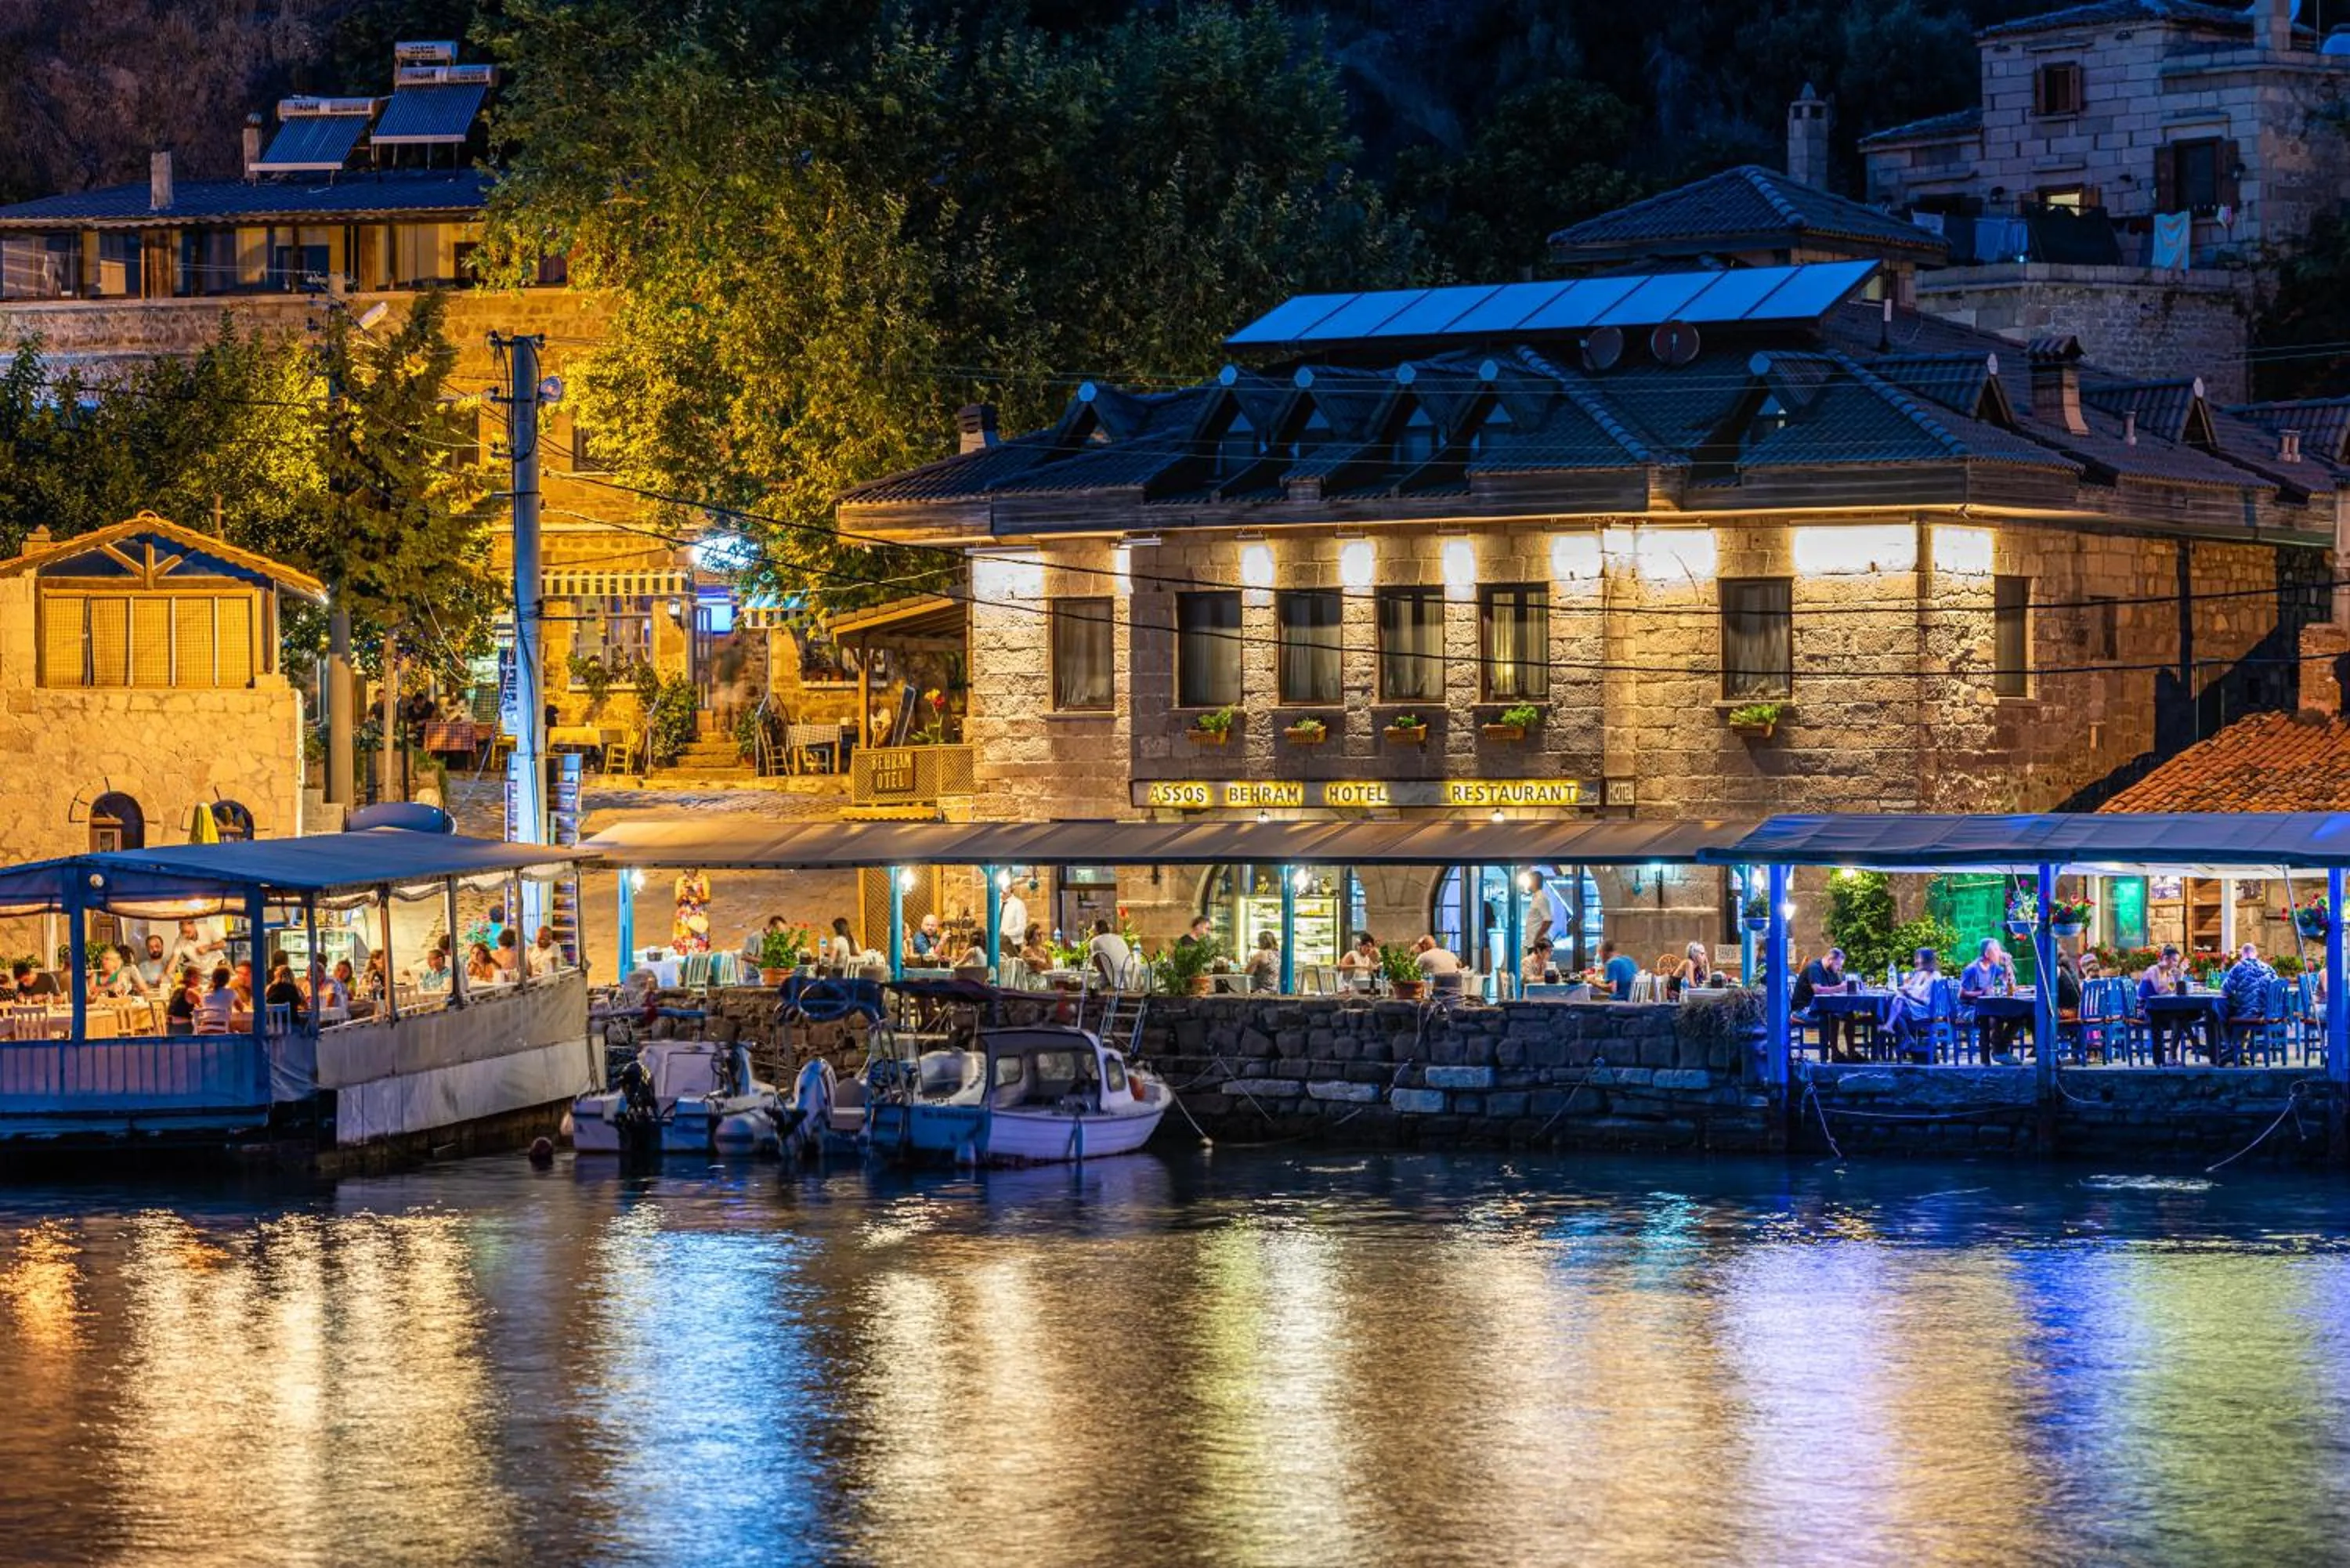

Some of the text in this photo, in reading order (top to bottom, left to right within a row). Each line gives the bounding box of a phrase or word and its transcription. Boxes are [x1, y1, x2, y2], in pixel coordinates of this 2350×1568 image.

[872, 753, 911, 770] BEHRAM
[877, 771, 905, 789] OTEL
[1150, 785, 1575, 803] ASSOS BEHRAM HOTEL RESTAURANT
[1608, 783, 1633, 802] HOTEL
